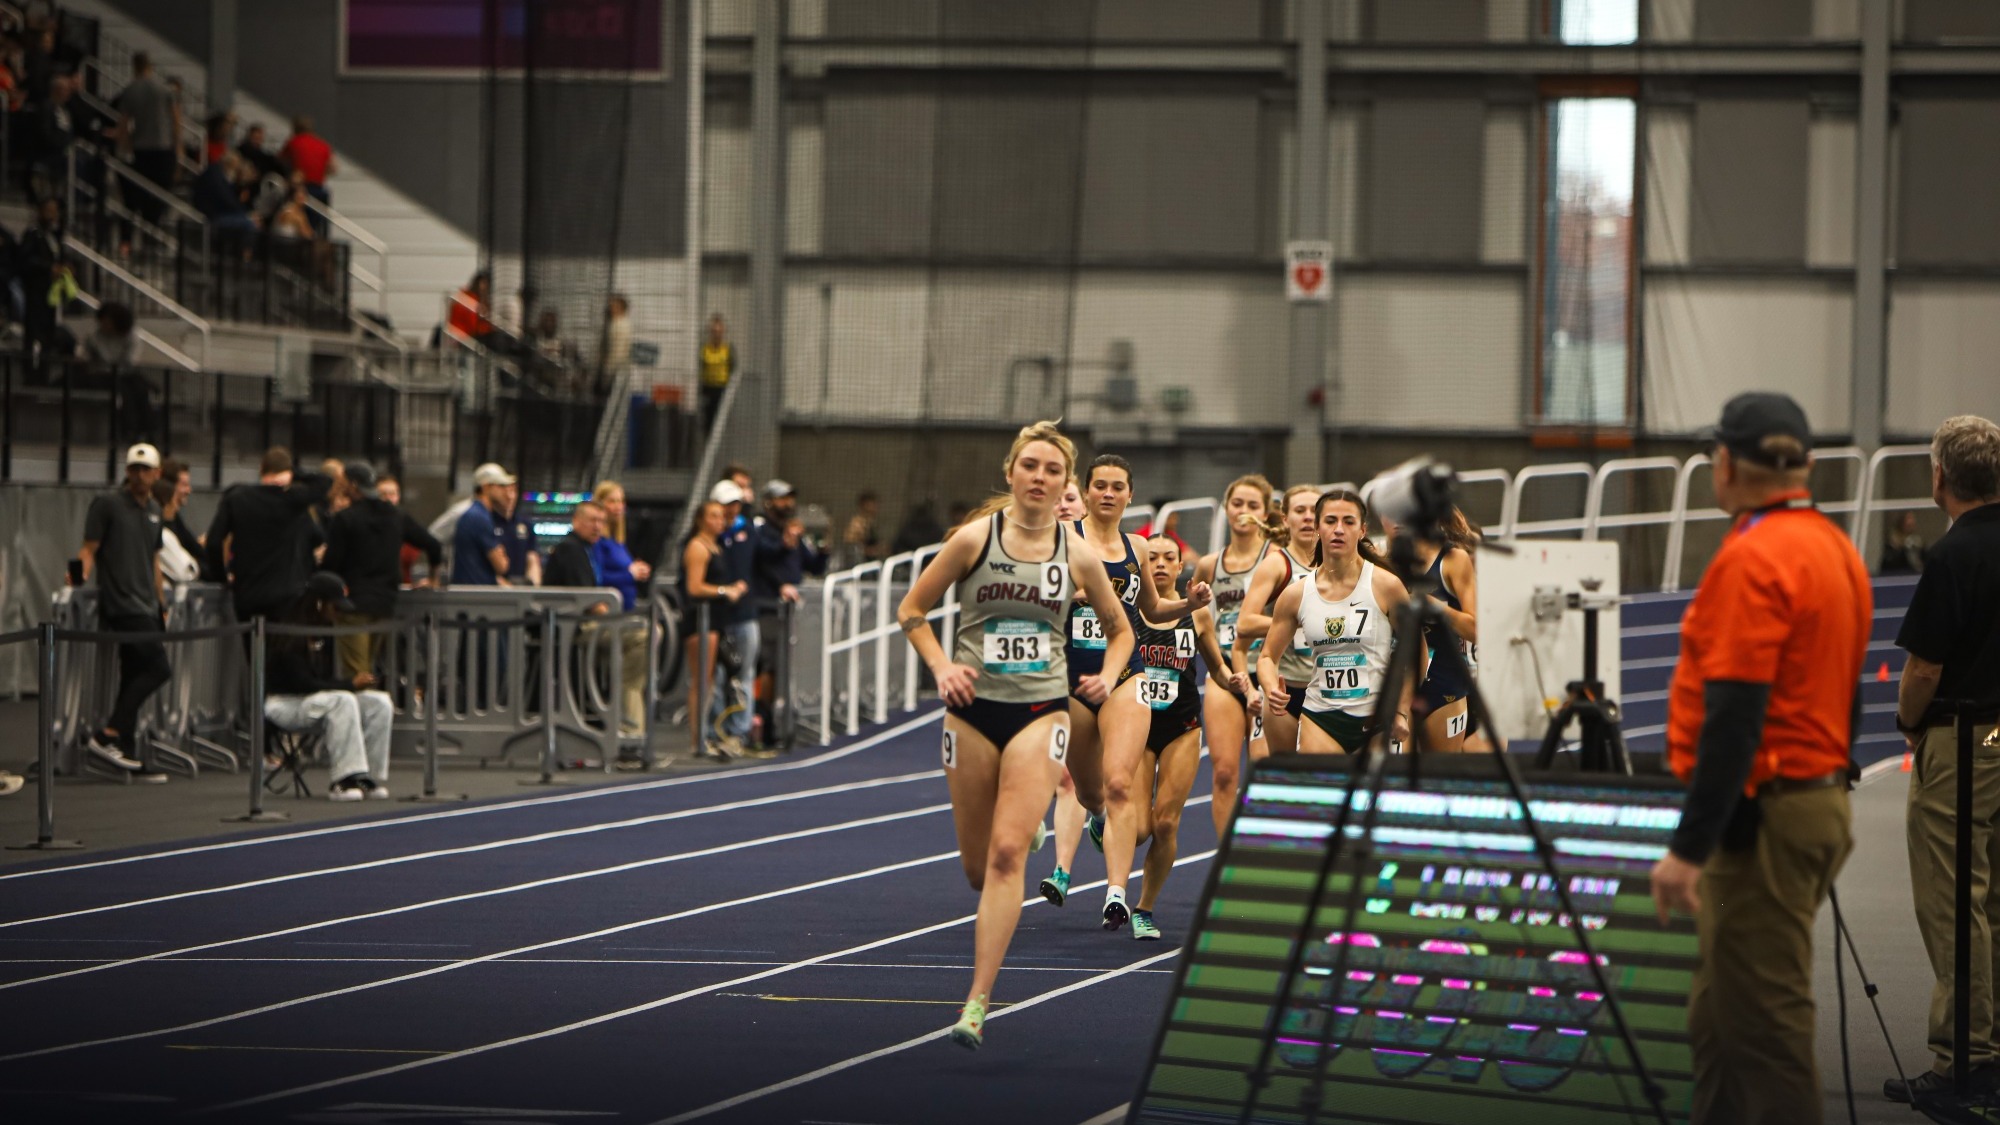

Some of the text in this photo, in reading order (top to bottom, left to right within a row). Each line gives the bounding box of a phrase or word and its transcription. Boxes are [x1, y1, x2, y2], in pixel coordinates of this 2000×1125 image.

[1047, 565, 1063, 598] 9
[1125, 577, 1139, 602] 3
[1082, 619, 1105, 638] 83
[1355, 609, 1369, 636] 7
[996, 636, 1040, 661] 363
[1180, 631, 1192, 656] 4
[1139, 644, 1190, 671] ASTE
[1148, 681, 1169, 701] 93
[1325, 668, 1359, 689] 670
[1451, 714, 1465, 735] 11
[944, 731, 951, 764] 9
[1055, 728, 1066, 760] 9
